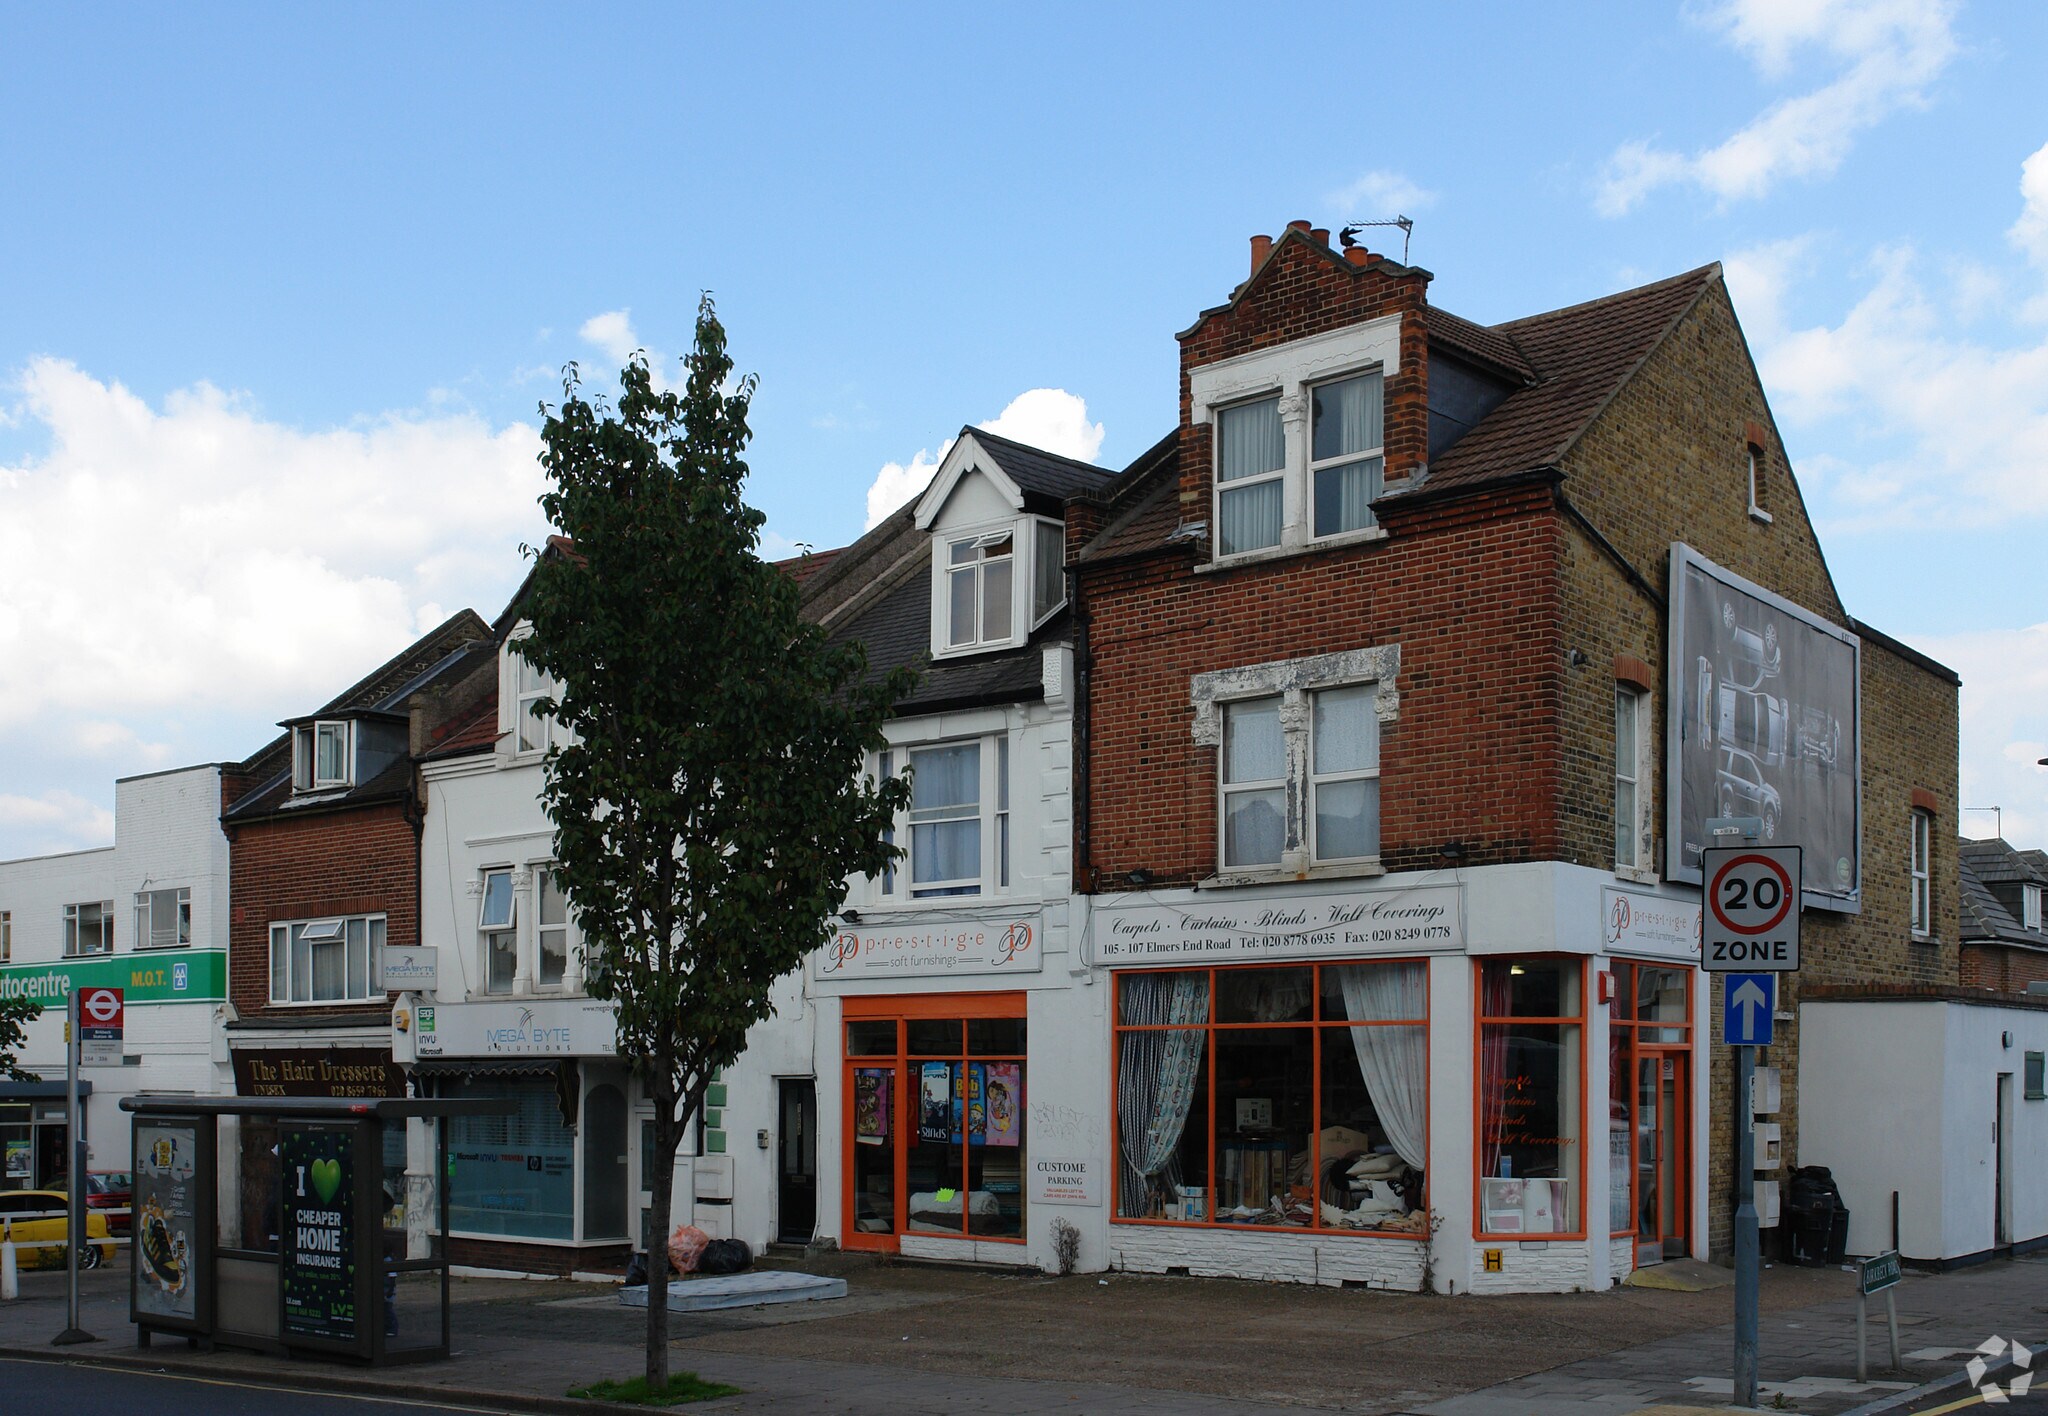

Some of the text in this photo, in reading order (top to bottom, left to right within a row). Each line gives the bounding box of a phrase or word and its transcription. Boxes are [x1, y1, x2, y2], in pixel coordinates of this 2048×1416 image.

[1724, 878, 1780, 910] 20
[1111, 901, 1445, 939] Carpets Curtains Blinds Wall Coverings
[1103, 944, 1119, 954] 105
[1128, 943, 1143, 953] 107
[1147, 941, 1180, 953] Elmers
[1183, 940, 1202, 951] End
[1205, 938, 1231, 950] Road
[1239, 936, 1259, 948] Tel:
[1262, 936, 1280, 948] 020
[1284, 934, 1308, 946] 8778
[1311, 933, 1336, 944] 6935
[1344, 931, 1369, 943] Fax:
[1372, 930, 1391, 942] 020
[1394, 928, 1420, 940] 8249
[1424, 926, 1451, 938] 0778
[1712, 941, 1787, 961] ZONE
[890, 954, 957, 968] soft furnishings
[131, 970, 167, 987] M.O.T.
[487, 1029, 570, 1042] MEGA BYTE
[249, 1059, 386, 1082] The Hair Dressers
[1037, 1162, 1087, 1173] CUSTOME
[296, 1165, 306, 1197] I
[1047, 1176, 1083, 1185] PARKING
[296, 1208, 341, 1227] CHEAPER
[296, 1227, 341, 1252] HOME
[296, 1253, 341, 1269] INSURANCE
[1487, 1252, 1500, 1270] H
